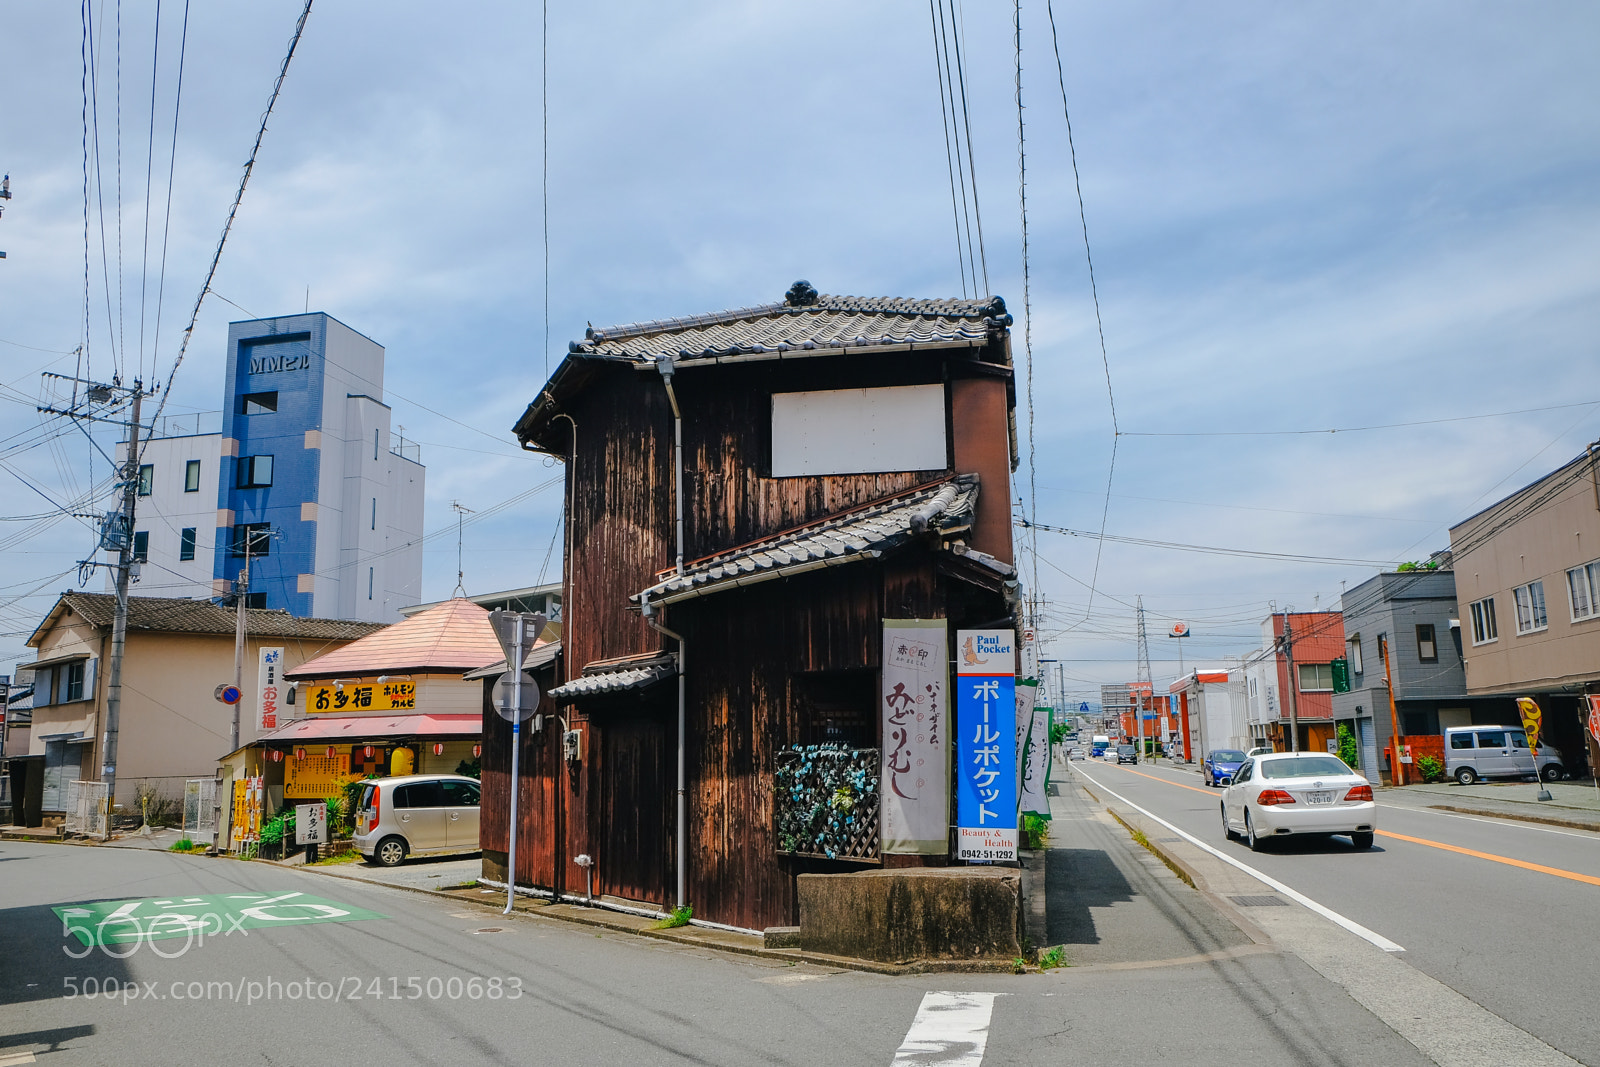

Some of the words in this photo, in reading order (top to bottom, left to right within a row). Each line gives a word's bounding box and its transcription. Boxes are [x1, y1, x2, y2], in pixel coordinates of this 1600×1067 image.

[248, 354, 310, 375] MMビル
[976, 635, 999, 645] Paul
[977, 644, 1011, 654] Pocket
[384, 684, 415, 697] ホルモン
[315, 686, 373, 710] お多福
[391, 698, 415, 708] カルビ
[262, 686, 277, 728] お多福
[885, 681, 918, 800] みどりむし
[973, 680, 1000, 824] ポールポケット
[307, 807, 319, 841] お多福
[962, 829, 991, 838] Beauty
[994, 829, 1002, 837] &
[984, 839, 1013, 848] Health
[961, 849, 1013, 859] 0942-51-1292
